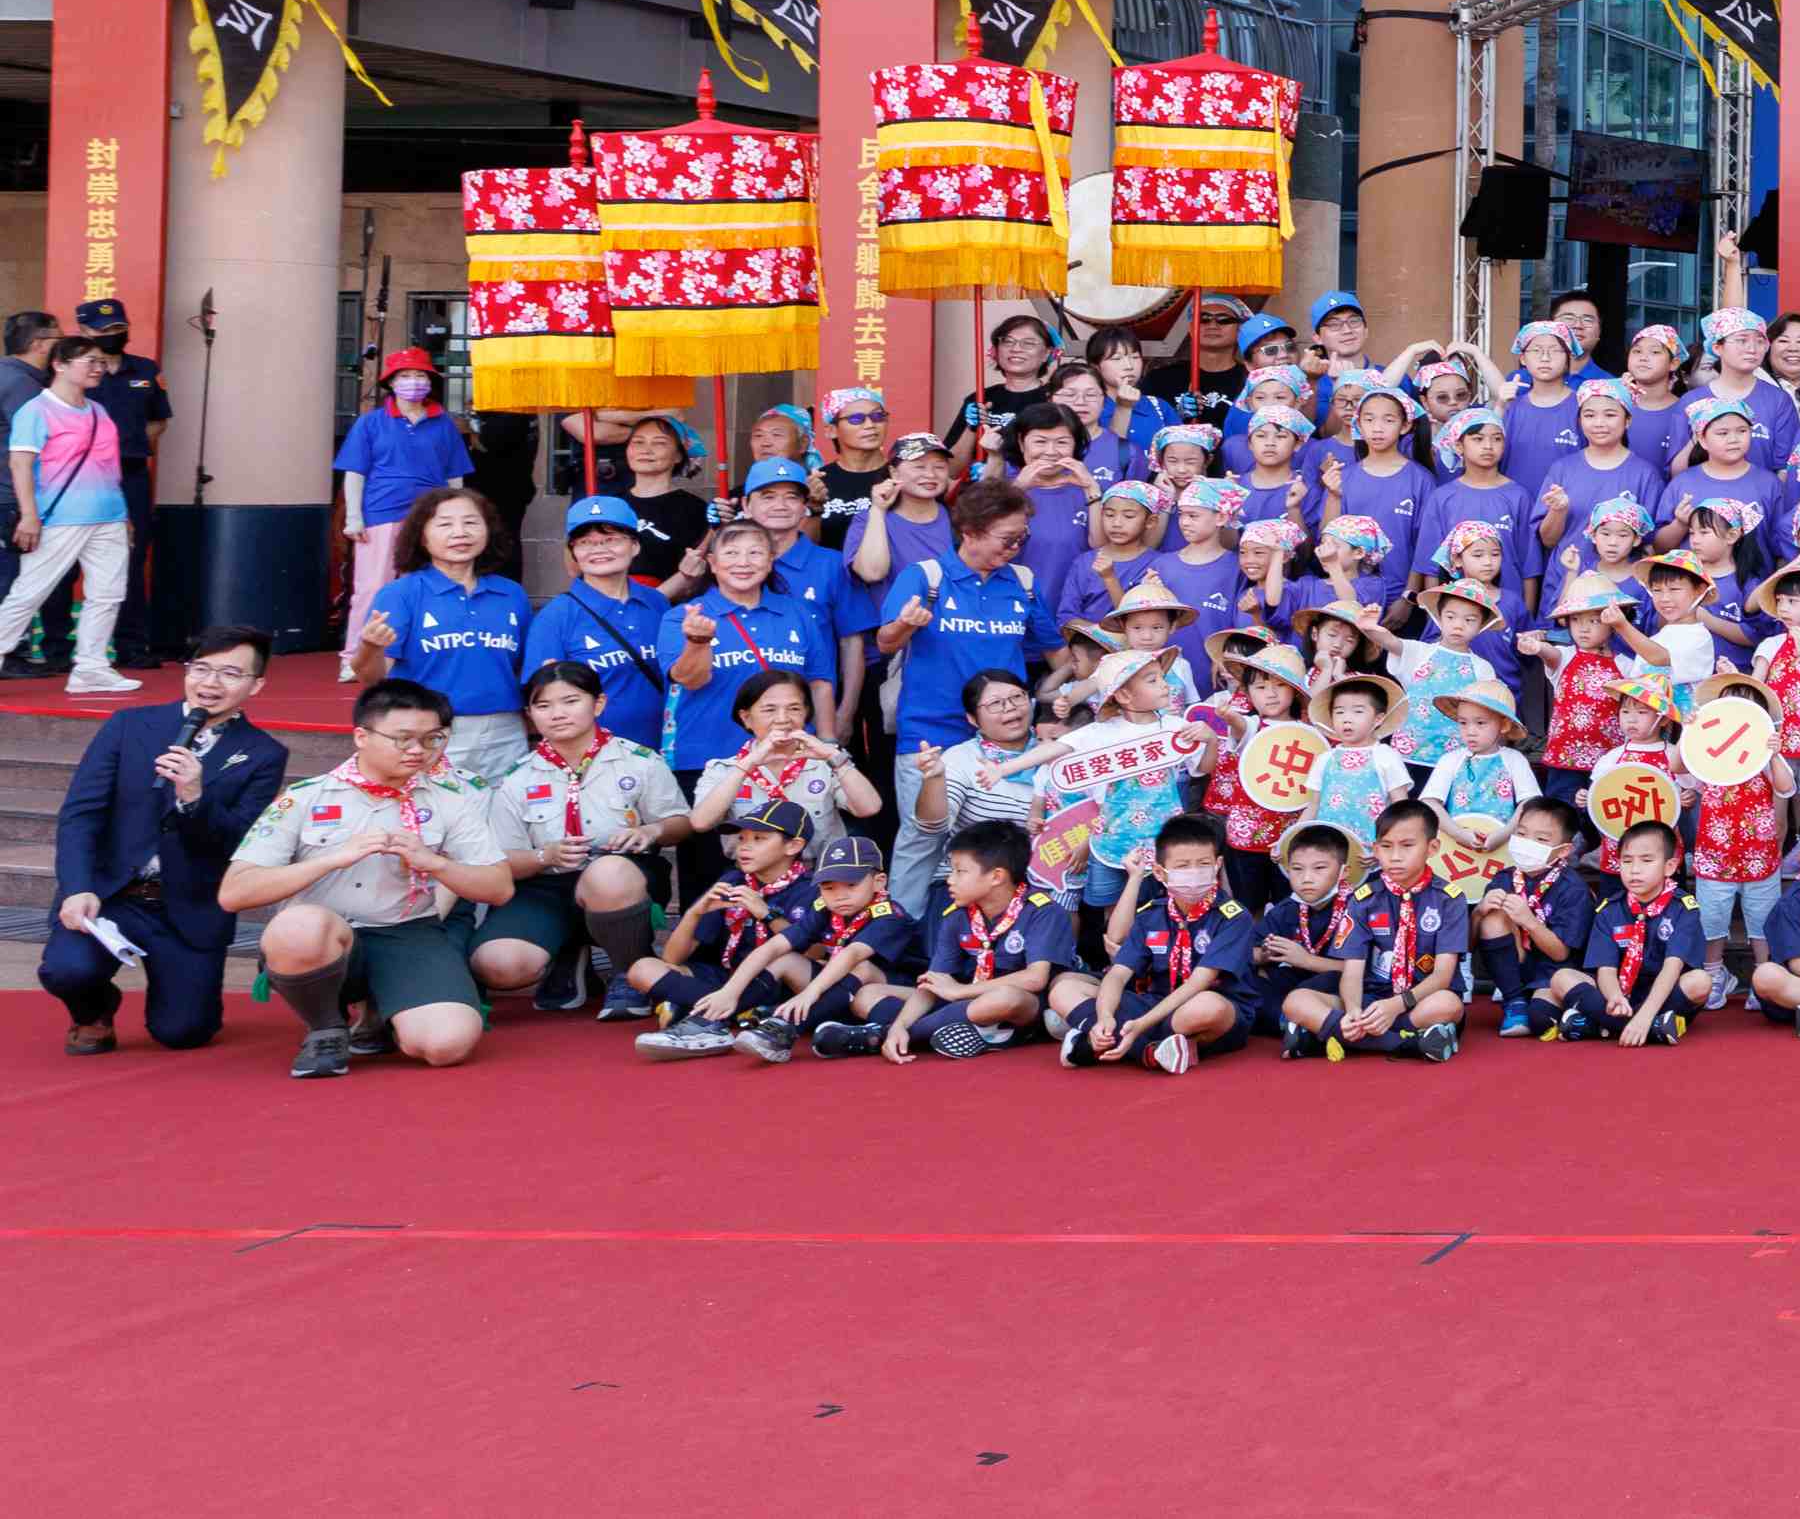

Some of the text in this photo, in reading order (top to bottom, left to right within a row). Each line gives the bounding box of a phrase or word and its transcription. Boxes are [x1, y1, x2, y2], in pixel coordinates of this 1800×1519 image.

[940, 618, 986, 633] NTPC
[421, 632, 476, 653] NTPC
[760, 648, 804, 666] Hakka
[1256, 740, 1315, 797] 忠
